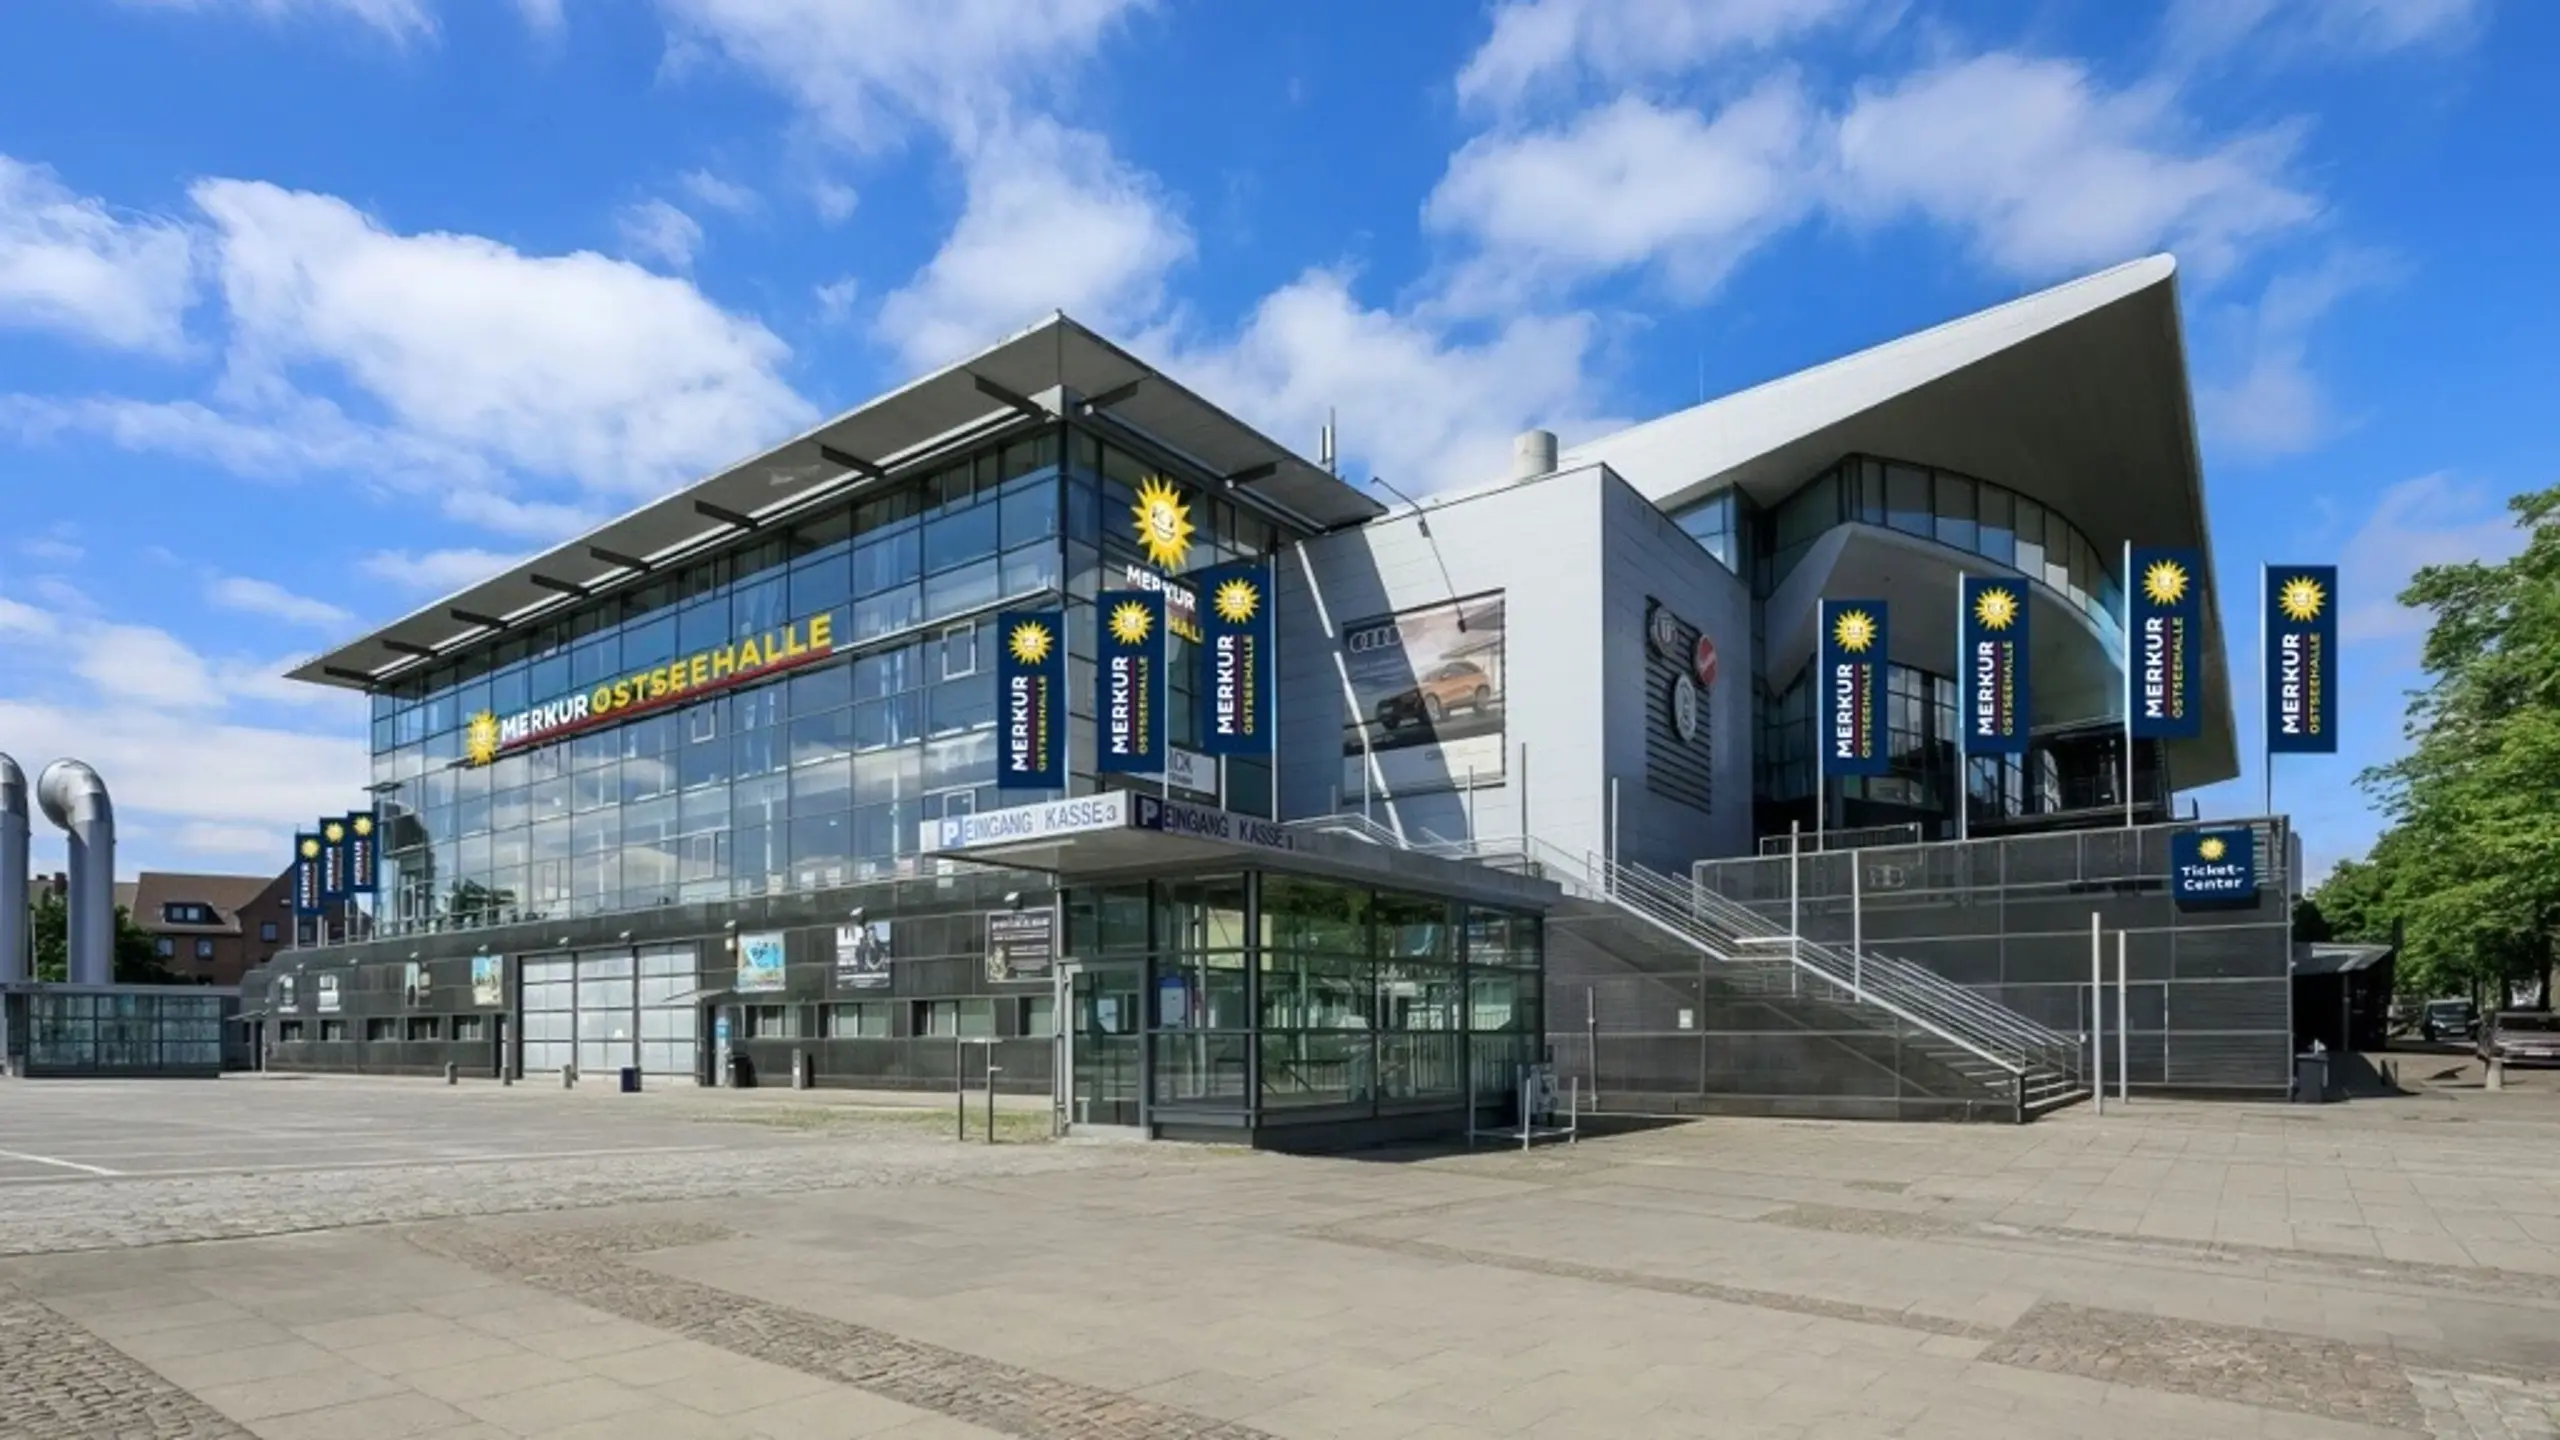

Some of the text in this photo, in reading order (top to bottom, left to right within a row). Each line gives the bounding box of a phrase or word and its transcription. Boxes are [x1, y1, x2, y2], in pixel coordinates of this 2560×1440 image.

[501, 613, 832, 742] MERKUR OSTSEEHALLE
[1111, 656, 1129, 754] MERKUR
[1217, 635, 1234, 734] MERKUR
[1836, 664, 1853, 758] MERKUR
[1977, 641, 1995, 736] MERKUR
[2145, 616, 2164, 719] MERKUR
[2171, 616, 2184, 719] OSTSEEHALLE
[2281, 633, 2300, 734] MERKUR
[2308, 632, 2321, 735] OSTSEEHALLE
[1011, 676, 1028, 771] MERKUR
[942, 802, 1117, 847] P EINGANG KASSE 3
[1141, 799, 1159, 826] P
[1164, 804, 1229, 838] EINGANG
[1239, 819, 1284, 849] KASSE
[2181, 864, 2245, 876] Ticket-
[2184, 877, 2243, 891] Center
